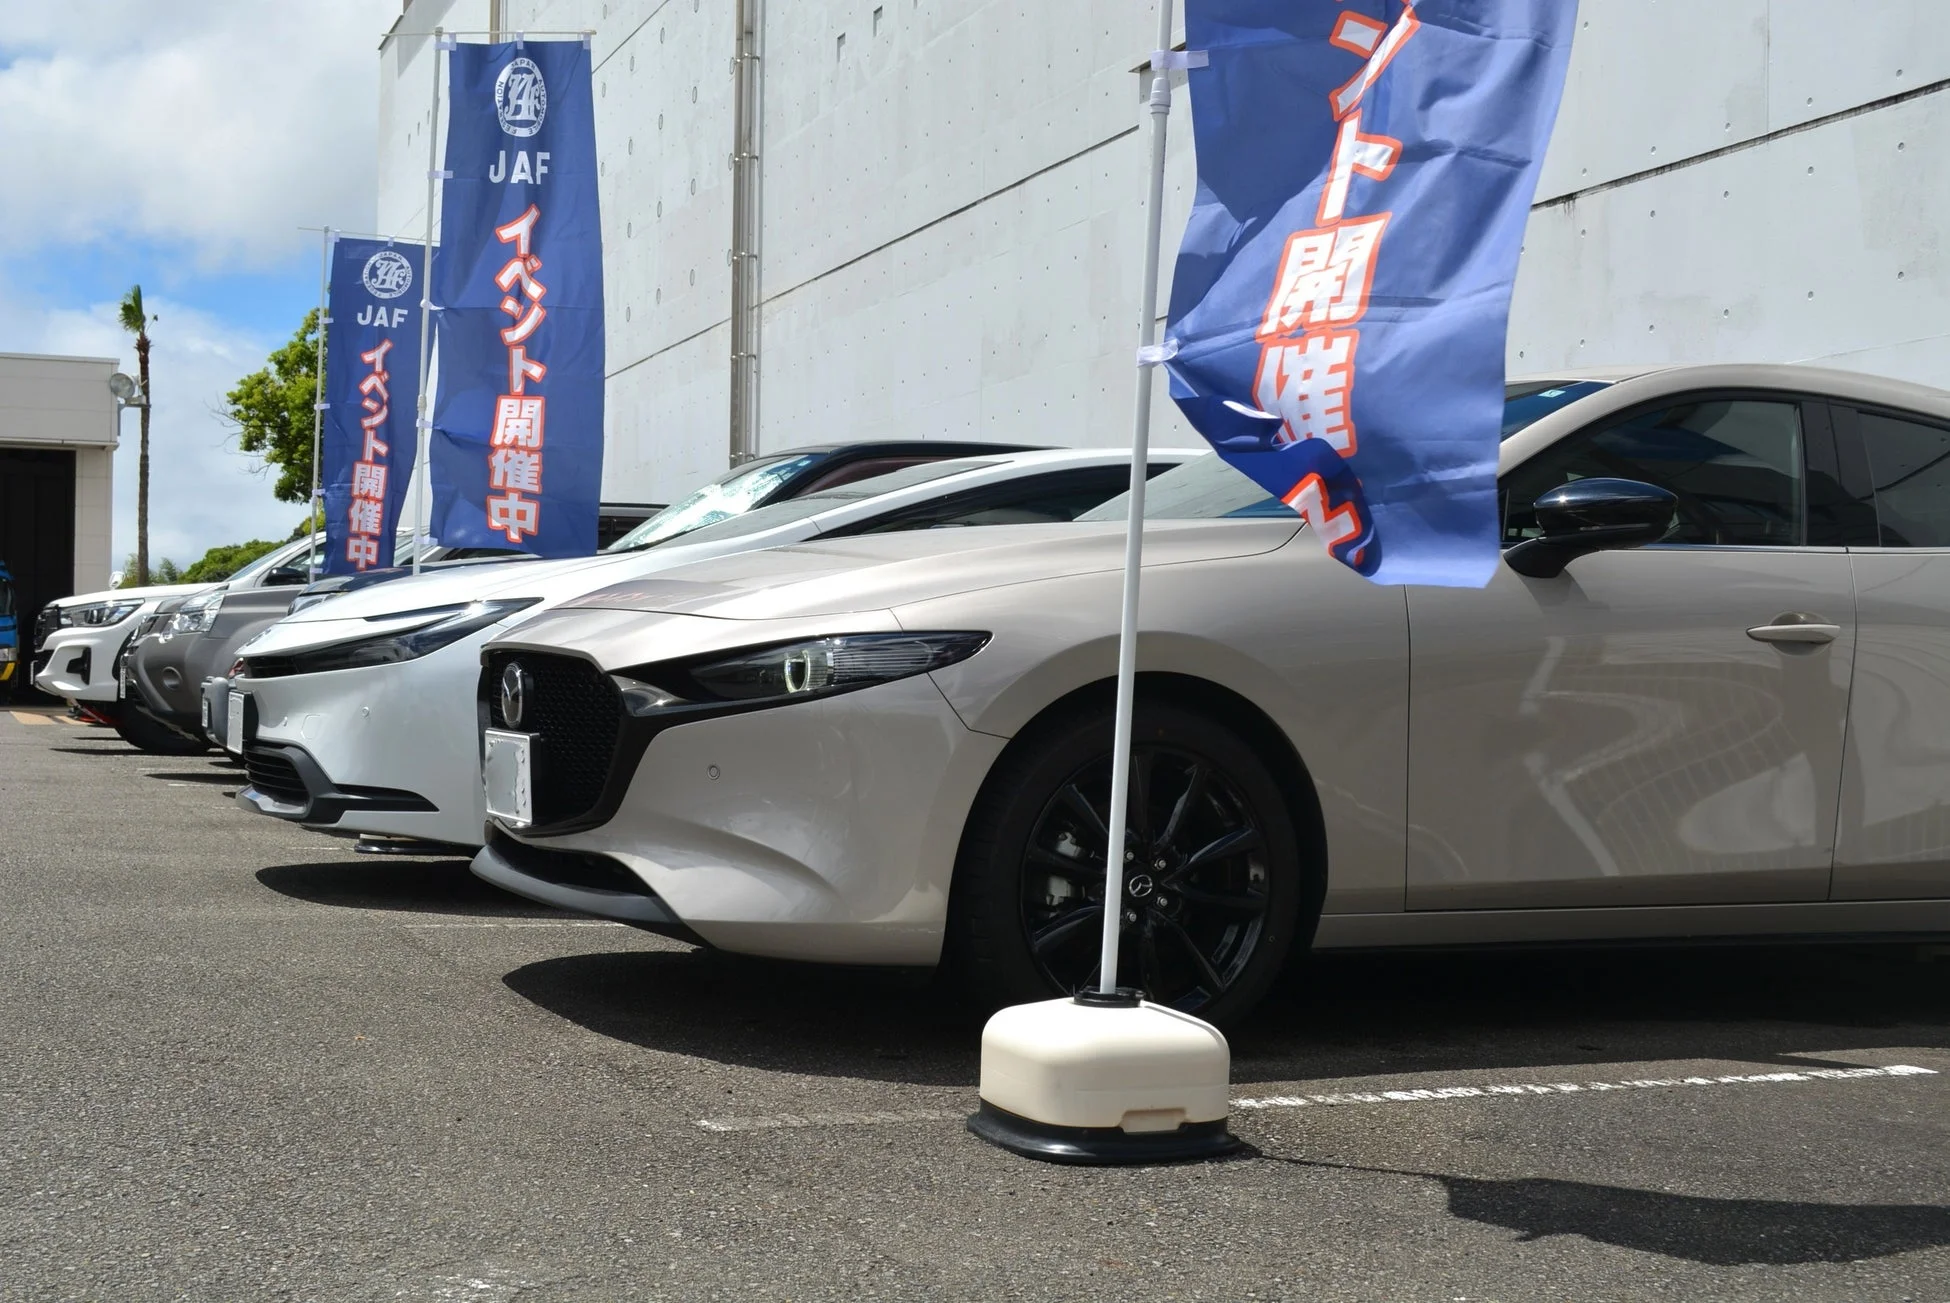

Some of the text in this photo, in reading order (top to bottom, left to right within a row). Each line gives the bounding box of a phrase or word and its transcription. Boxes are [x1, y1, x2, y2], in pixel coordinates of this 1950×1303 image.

[489, 150, 551, 185] JAF
[1251, 0, 1421, 562] ント開催
[357, 304, 409, 329] JAF
[487, 203, 547, 543] イベント開催中
[346, 338, 393, 571] イベント開催中
